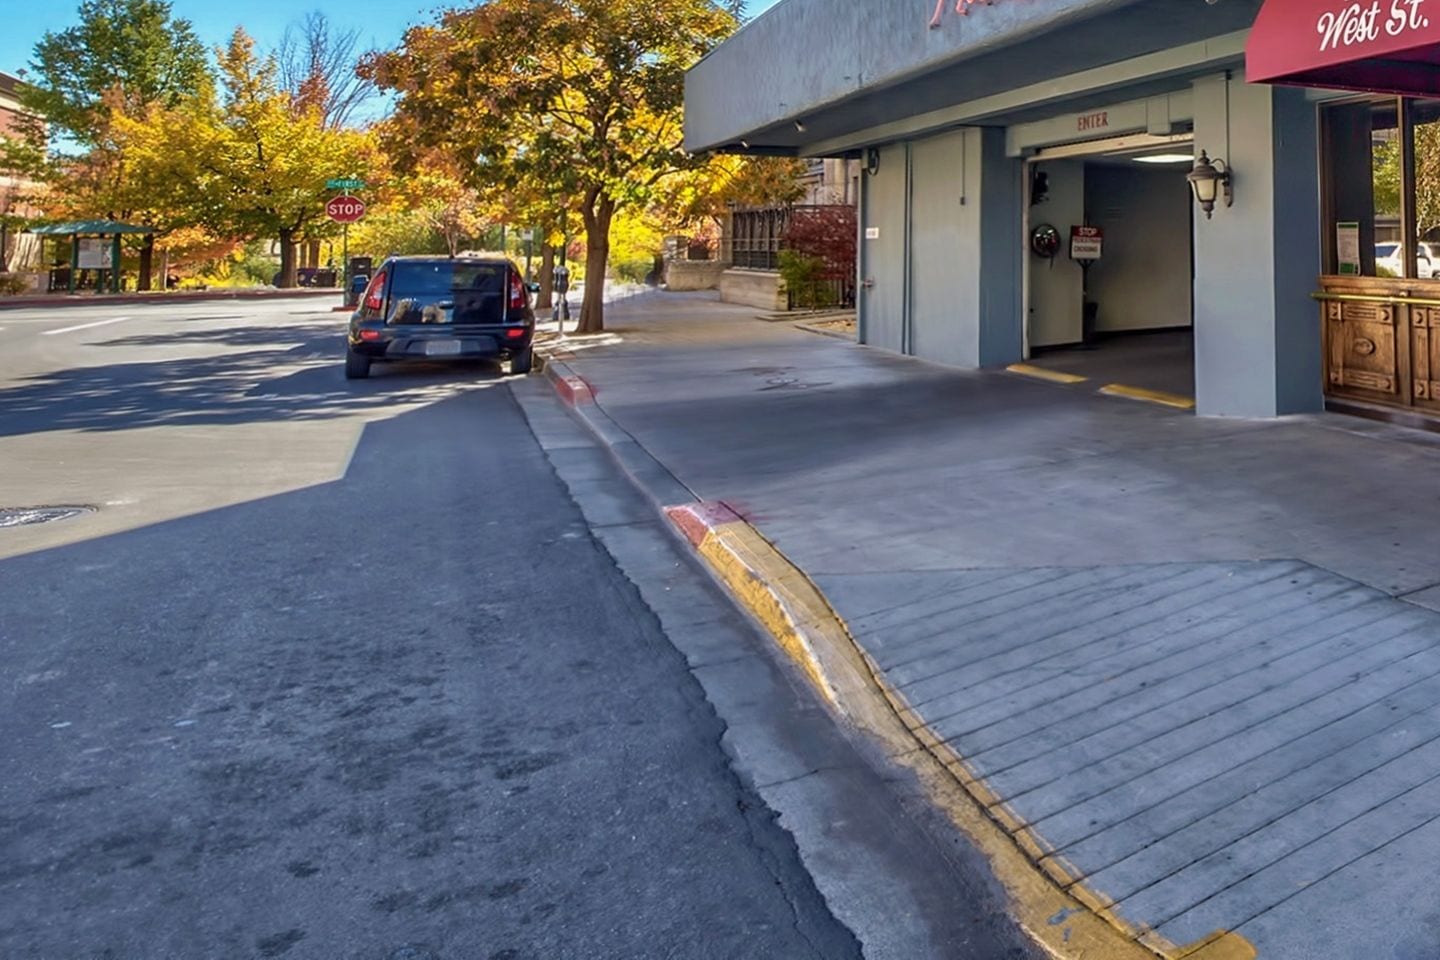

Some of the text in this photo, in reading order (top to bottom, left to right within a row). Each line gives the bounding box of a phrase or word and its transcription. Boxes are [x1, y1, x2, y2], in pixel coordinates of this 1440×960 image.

[1317, 0, 1381, 51] West
[1078, 111, 1109, 131] ENTER
[328, 203, 363, 215] STOP
[1078, 227, 1097, 237] STOP
